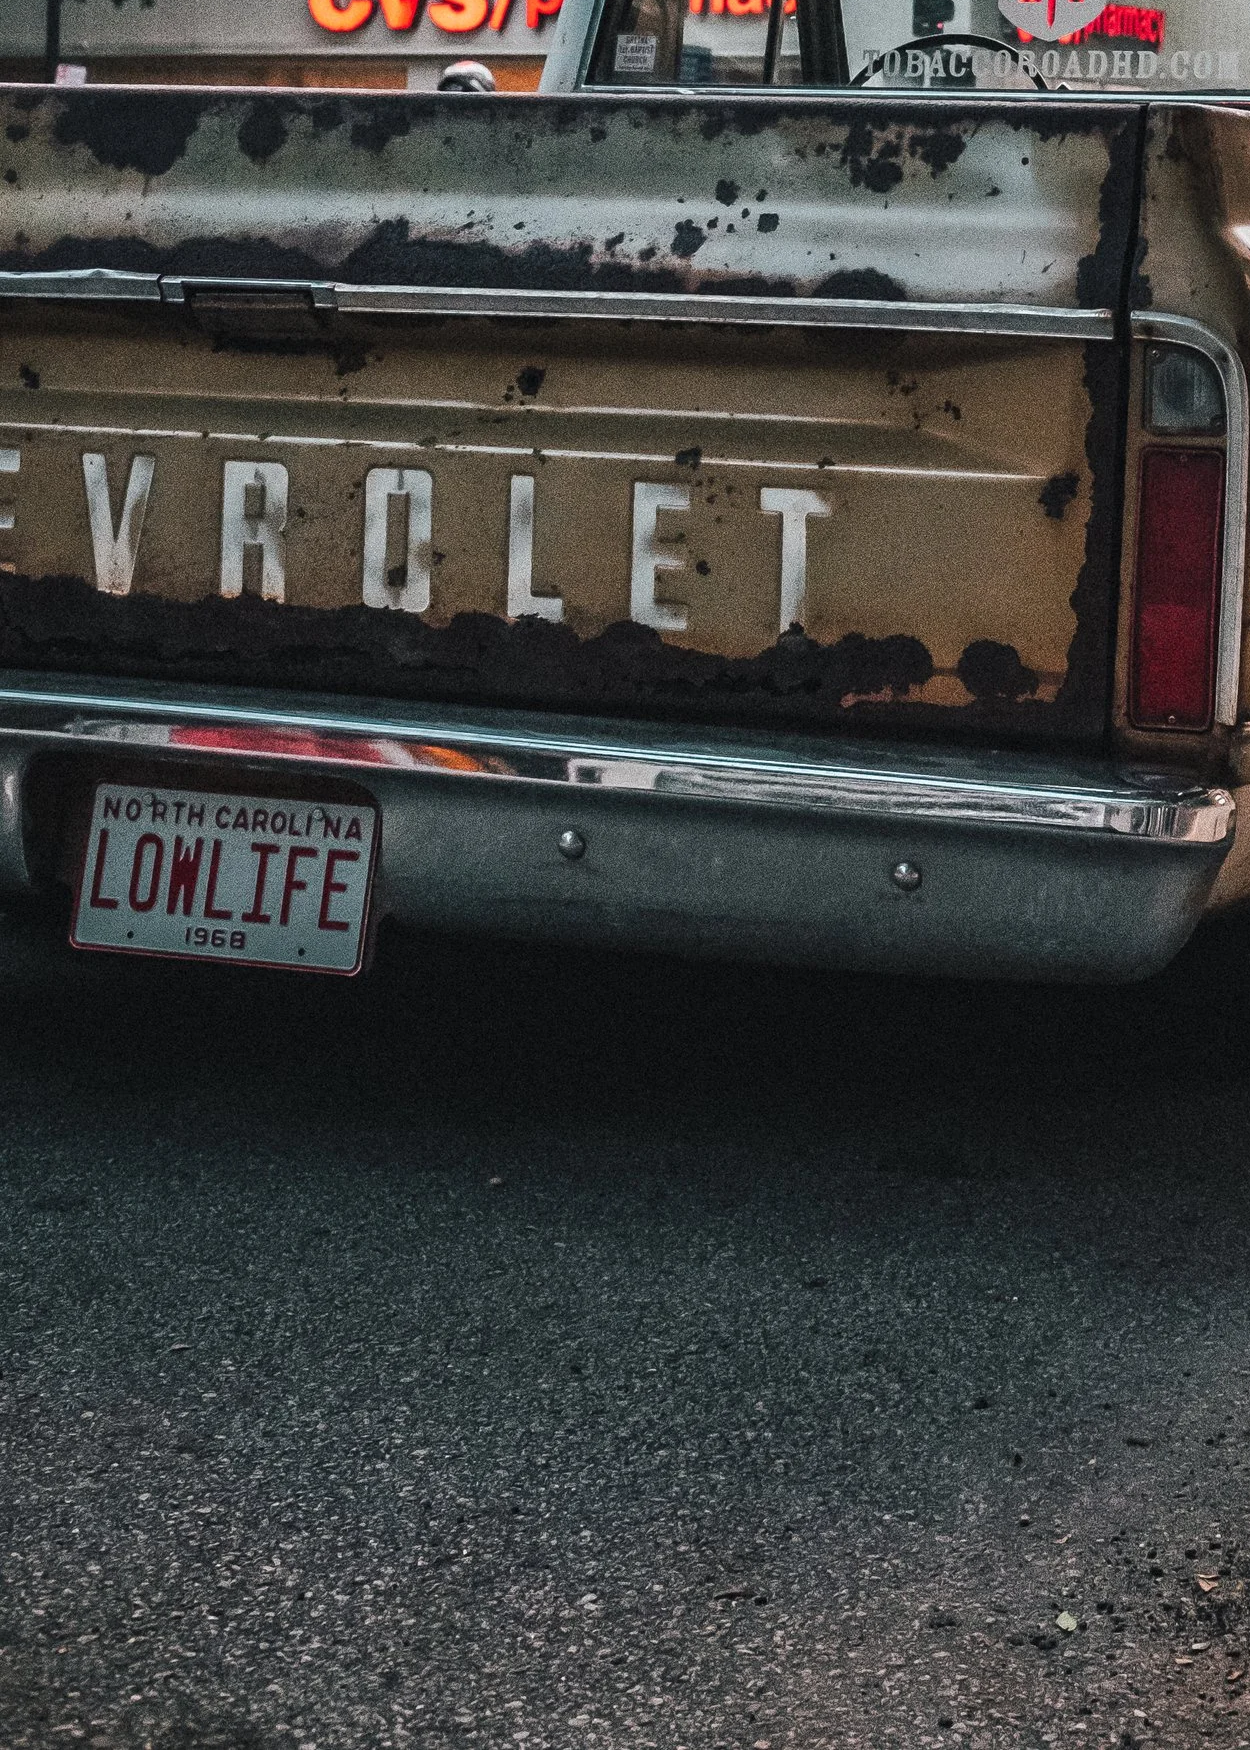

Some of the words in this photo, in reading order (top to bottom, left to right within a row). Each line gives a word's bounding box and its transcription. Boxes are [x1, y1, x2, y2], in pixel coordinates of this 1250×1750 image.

[102, 796, 206, 827] NORTH
[214, 805, 363, 841] CAROLINA
[89, 828, 361, 932] LOWLIFE
[184, 926, 247, 950] 1968
